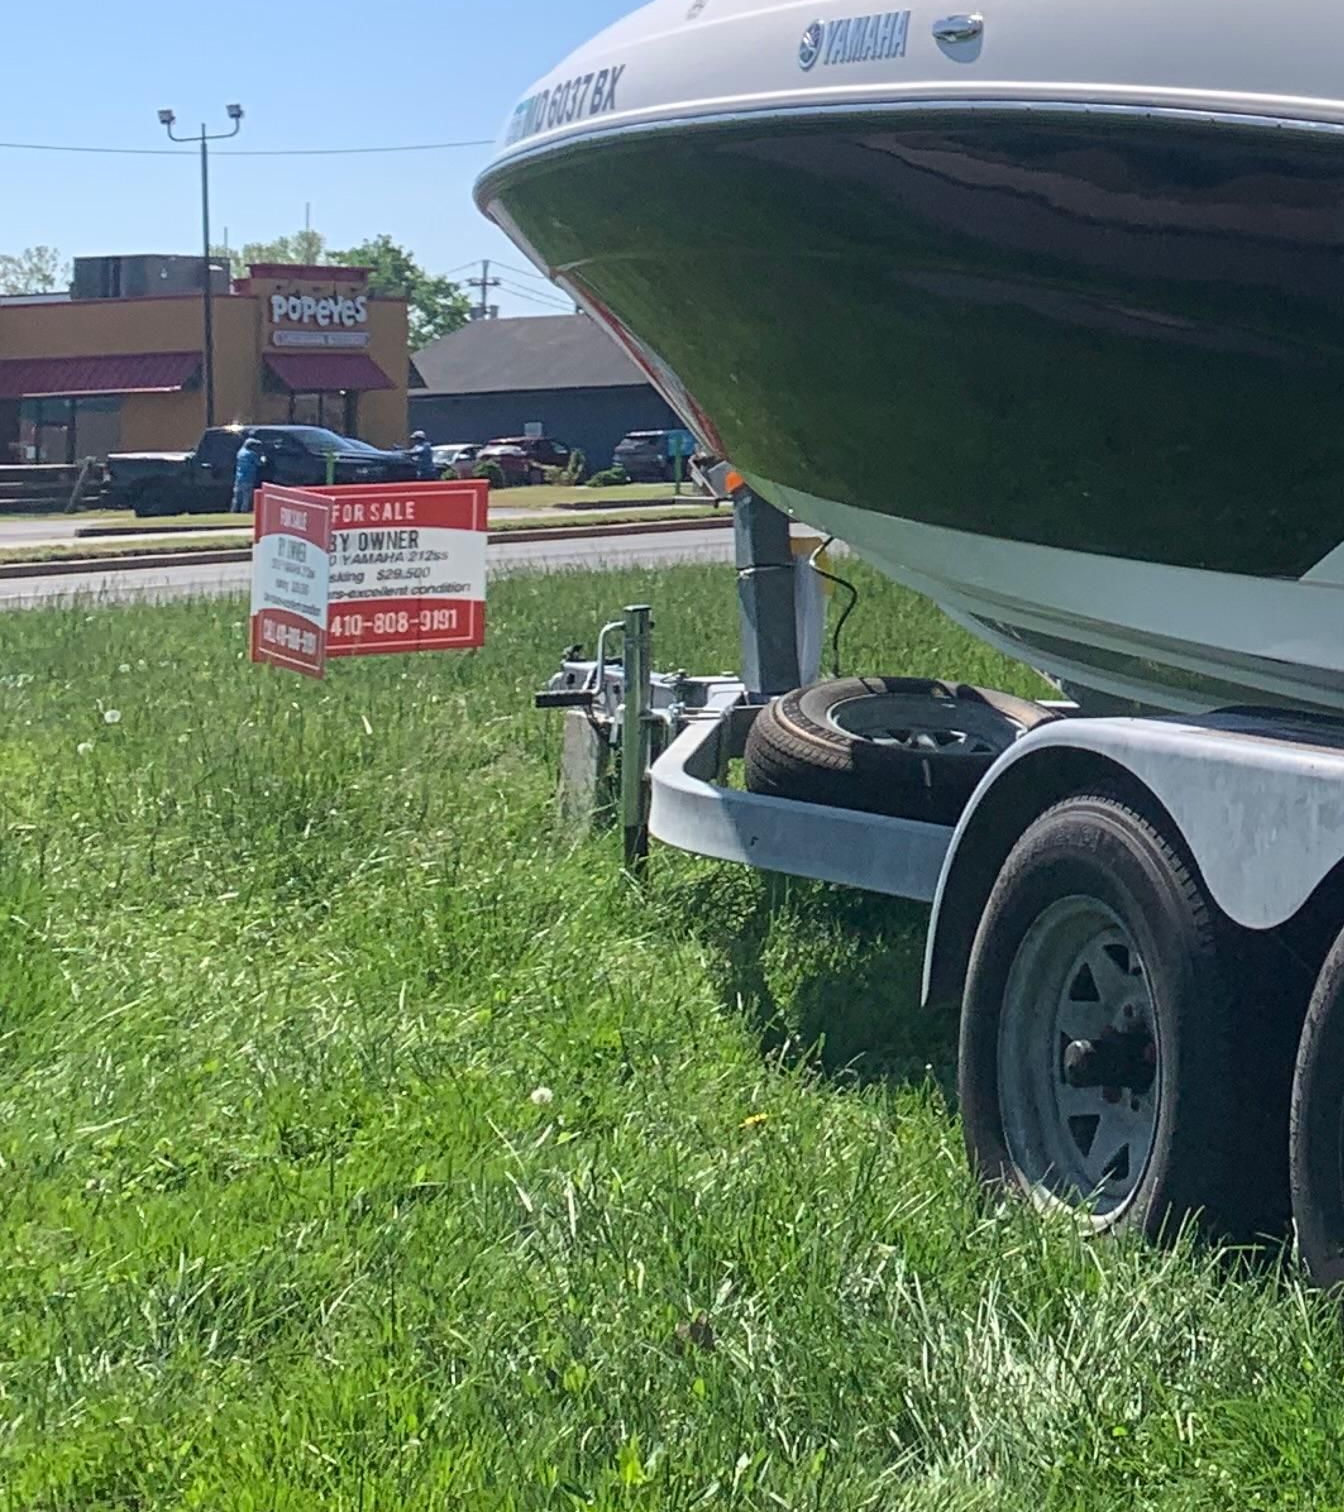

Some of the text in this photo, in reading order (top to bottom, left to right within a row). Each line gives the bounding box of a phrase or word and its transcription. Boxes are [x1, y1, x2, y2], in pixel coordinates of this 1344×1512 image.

[823, 10, 911, 65] YAMAHA
[547, 72, 595, 129] 6037
[589, 63, 626, 116] BX
[332, 500, 416, 523] FOR SALE
[328, 529, 419, 553] BY OWNER
[342, 551, 405, 566] YAMAHA
[328, 569, 365, 585] sking
[410, 581, 472, 596] condition
[329, 608, 458, 637] 410-808-9191
